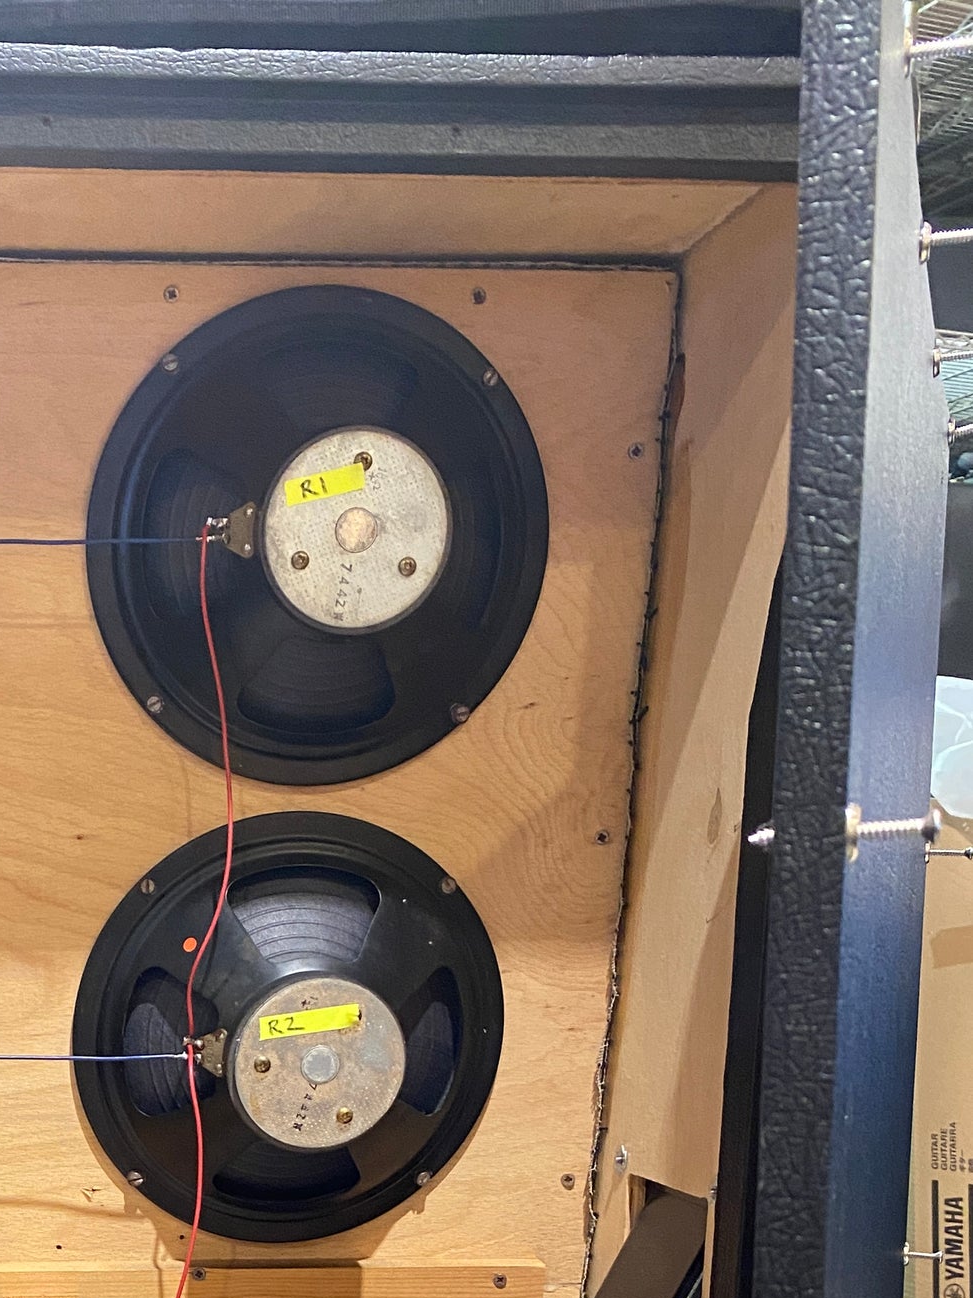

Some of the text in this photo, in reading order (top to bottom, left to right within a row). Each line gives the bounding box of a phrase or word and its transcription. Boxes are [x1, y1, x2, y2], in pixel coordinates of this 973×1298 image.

[299, 477, 328, 498] R1
[268, 1017, 305, 1035] R2
[931, 1133, 939, 1170] GUITAR
[940, 1128, 948, 1170] GUITARE
[949, 1121, 957, 1172] GUITARRA
[944, 1197, 964, 1281] YAMAHA
